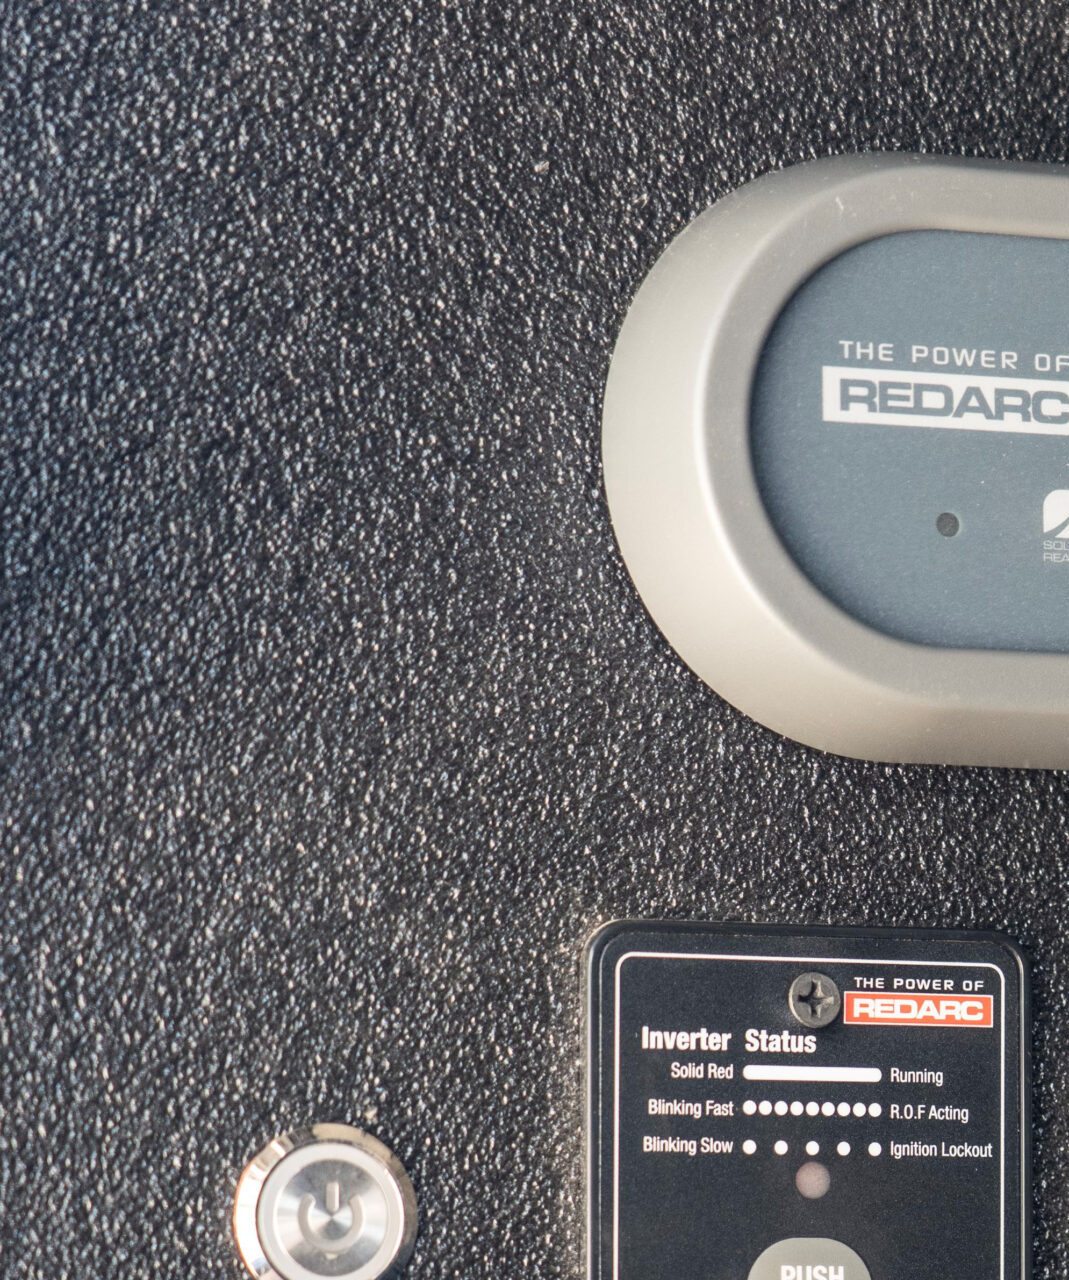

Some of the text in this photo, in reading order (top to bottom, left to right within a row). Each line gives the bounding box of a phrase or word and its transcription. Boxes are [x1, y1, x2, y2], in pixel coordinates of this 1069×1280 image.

[839, 340, 893, 362] THE
[912, 345, 1018, 369] POWER
[854, 976, 984, 991] THE POWER OF
[853, 997, 984, 1021] REDARC
[642, 1026, 817, 1053] Inverter Status
[670, 1062, 734, 1080] Solid Red
[890, 1067, 943, 1086] Running
[648, 1099, 734, 1118] Blinking Fast
[890, 1104, 969, 1123] R.O.F Acting
[643, 1136, 733, 1156] Blinking Slow
[890, 1142, 993, 1159] Ignition Lockout
